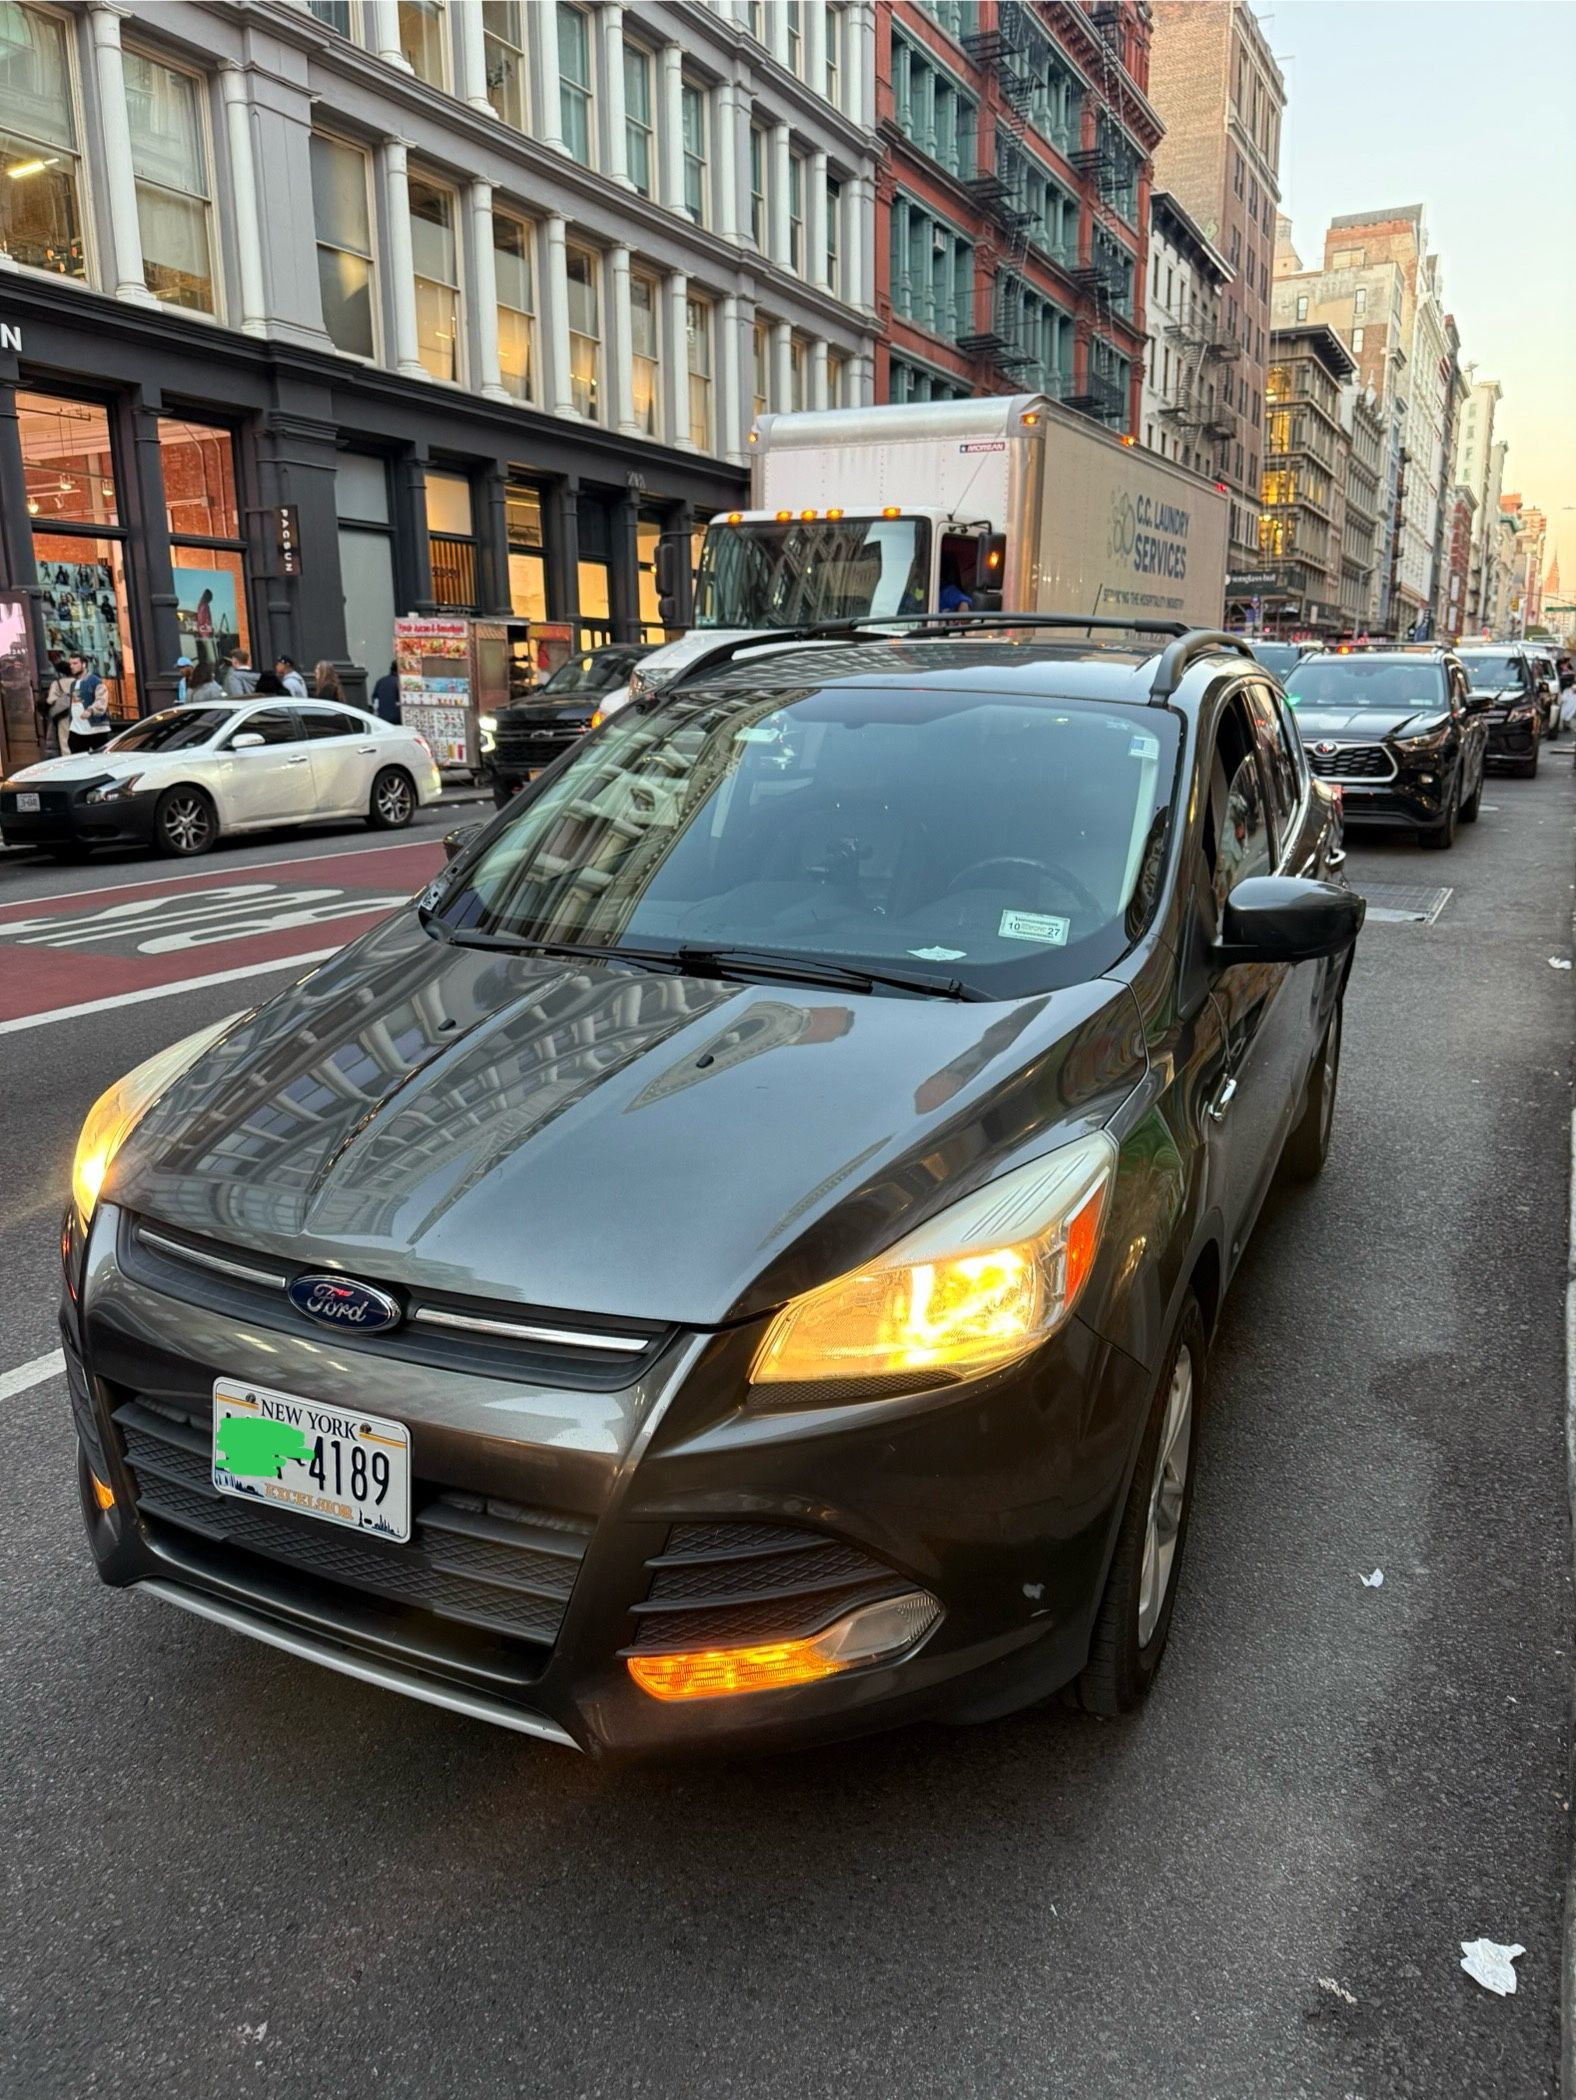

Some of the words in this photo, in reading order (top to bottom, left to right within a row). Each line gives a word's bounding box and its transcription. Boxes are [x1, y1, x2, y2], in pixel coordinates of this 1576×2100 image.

[1136, 494, 1152, 527] C.C.
[1154, 501, 1190, 539] LAUNDRY
[280, 508, 293, 572] PACSUN
[1134, 533, 1187, 580] SERVICES
[1008, 922, 1021, 931] 10
[1047, 927, 1061, 937] 27
[307, 1283, 368, 1323] Ford
[261, 1399, 304, 1425] NEW
[307, 1411, 358, 1441] YORK
[264, 1483, 354, 1520] EXCELSIOR
